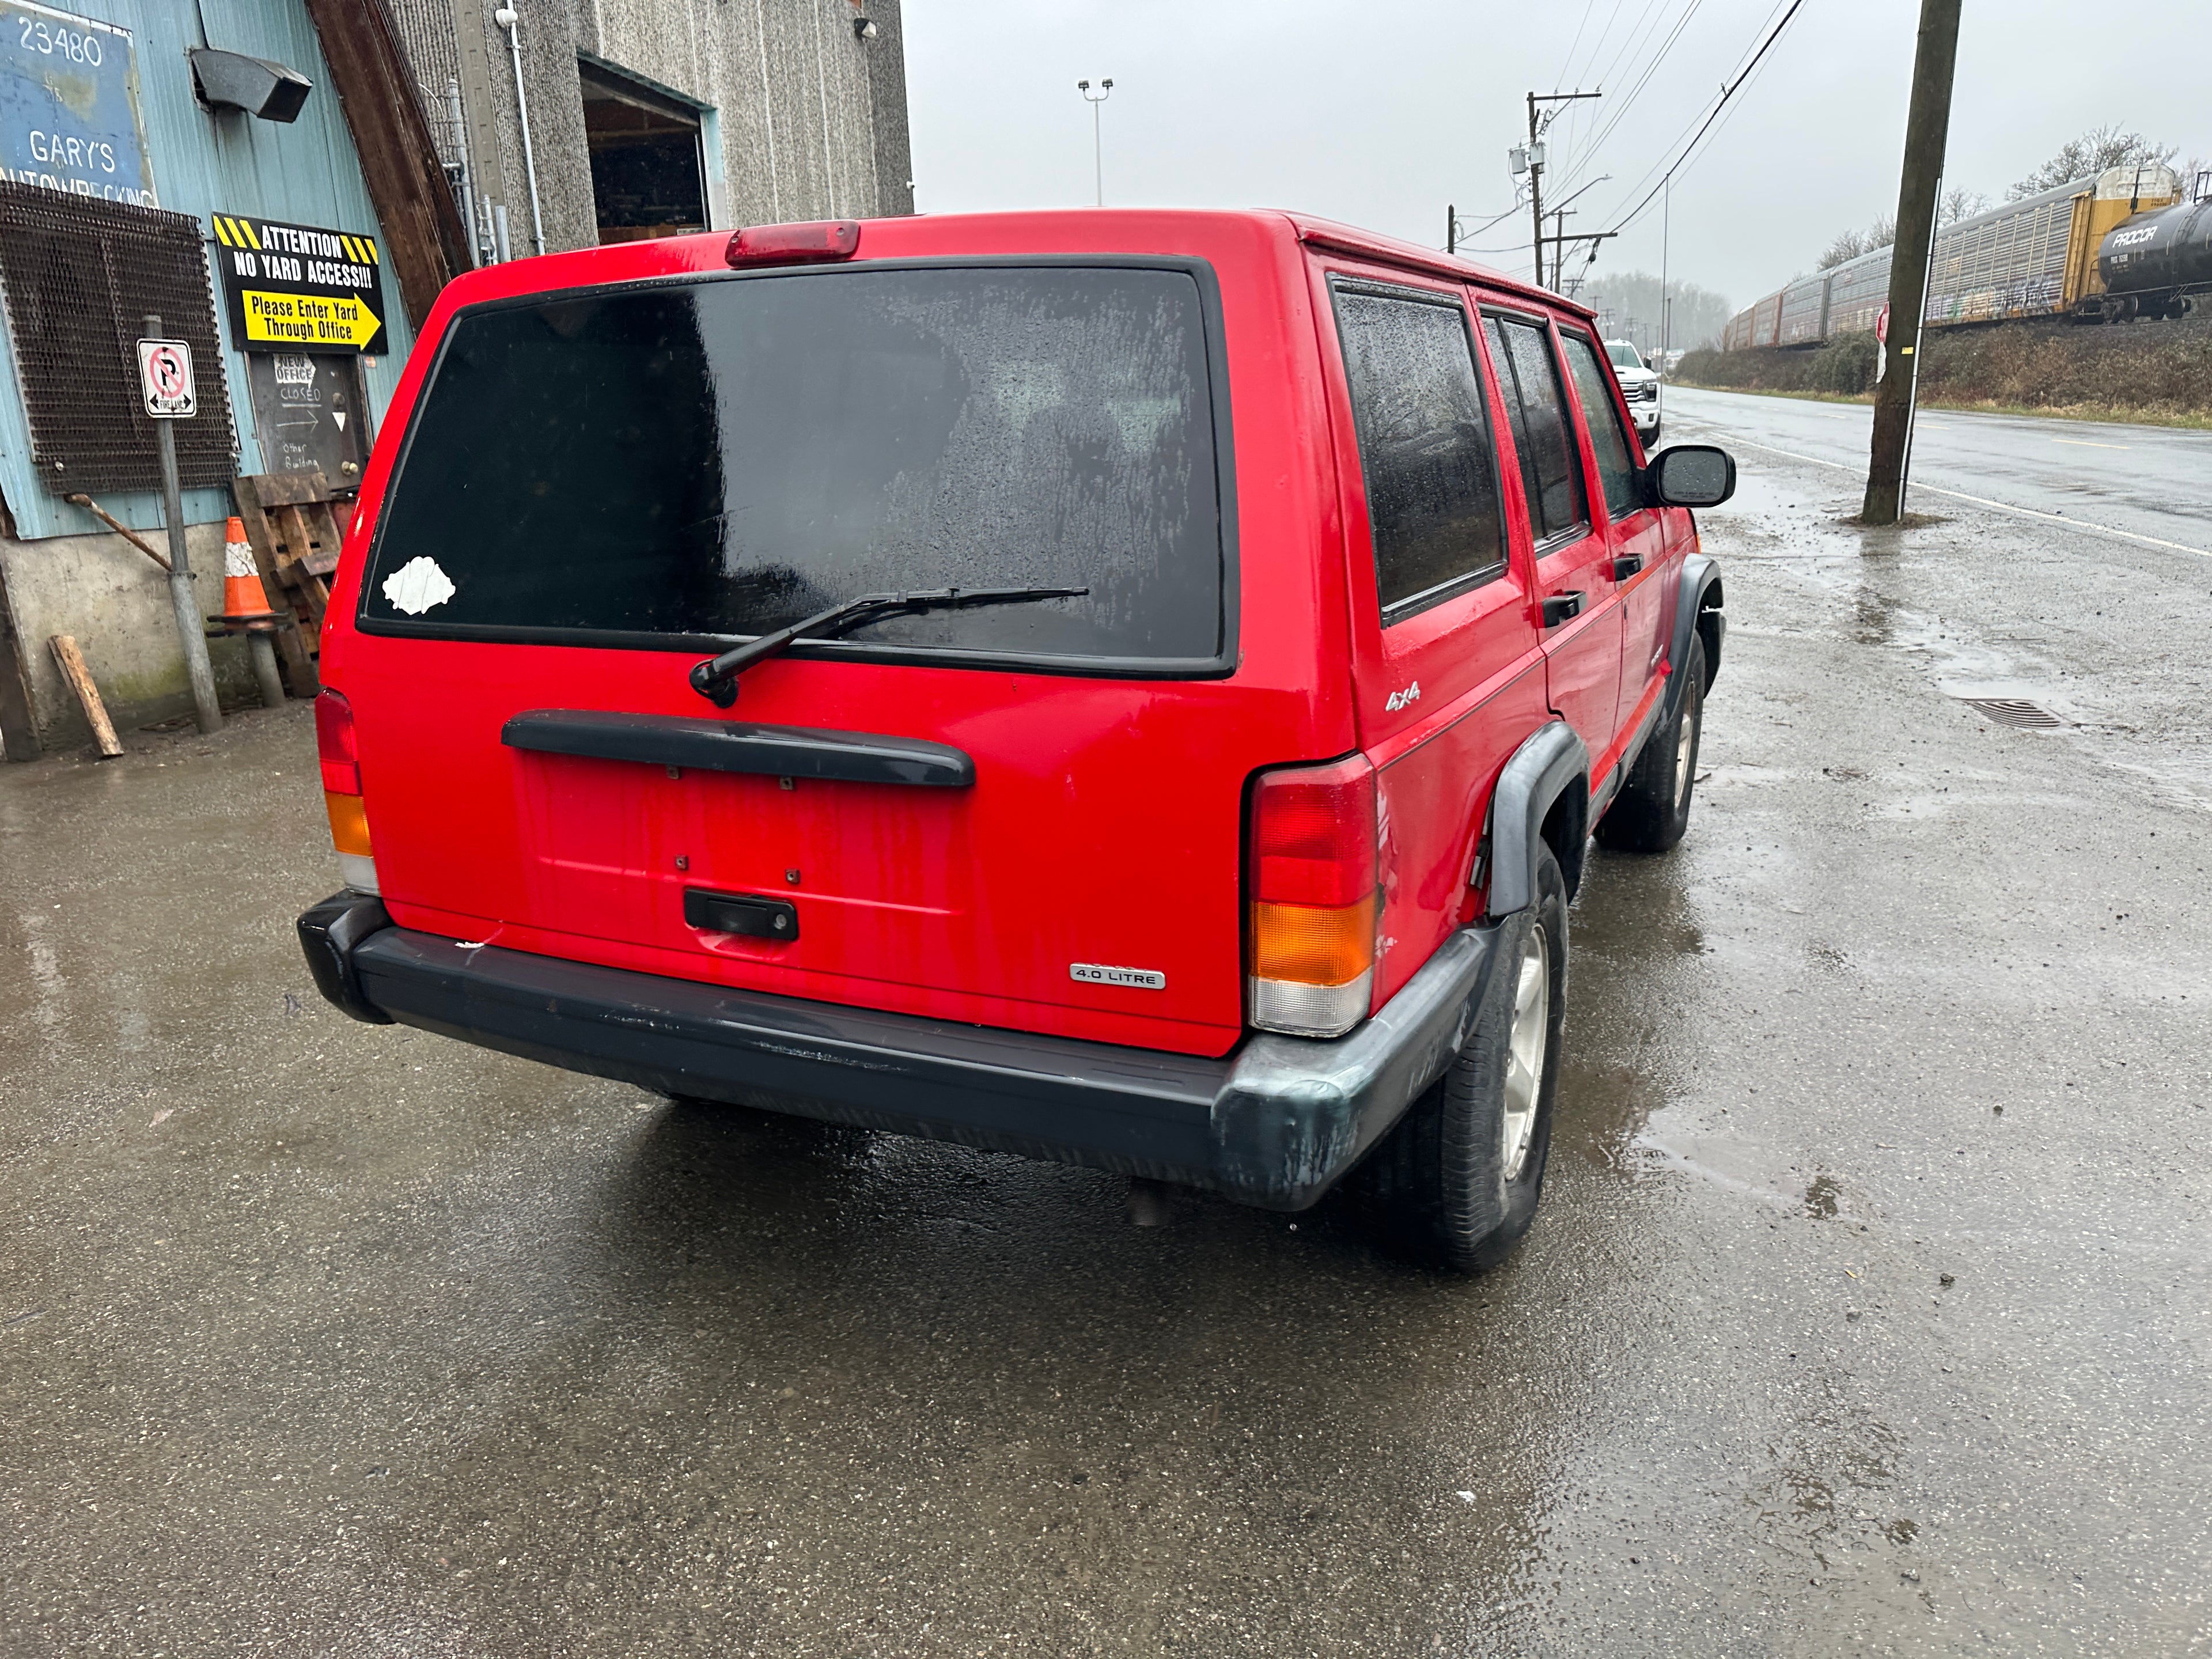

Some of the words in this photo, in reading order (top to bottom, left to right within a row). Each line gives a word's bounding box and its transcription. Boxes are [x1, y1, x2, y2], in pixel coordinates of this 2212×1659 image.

[18, 16, 101, 66] 23480
[29, 130, 115, 172] GARY'S
[262, 225, 342, 259] ATTENTION
[2112, 226, 2158, 248] PROCOR
[233, 251, 257, 277] NO
[260, 254, 301, 281] YARD
[308, 260, 372, 289] ACCESS!!!
[251, 296, 293, 317] Please
[298, 300, 328, 319] Enter
[333, 302, 358, 321] Yard
[264, 317, 313, 340] Through
[319, 321, 352, 339] Office
[279, 355, 305, 368] NEW
[276, 366, 312, 381] OFFICE
[160, 400, 171, 409] FIRE
[281, 387, 321, 401] CLOSED
[283, 443, 307, 453] Other
[285, 456, 320, 471] Building
[1385, 681, 1421, 711] 4x4
[1076, 969, 1101, 979] 4.0
[1109, 972, 1156, 984] LITRE
